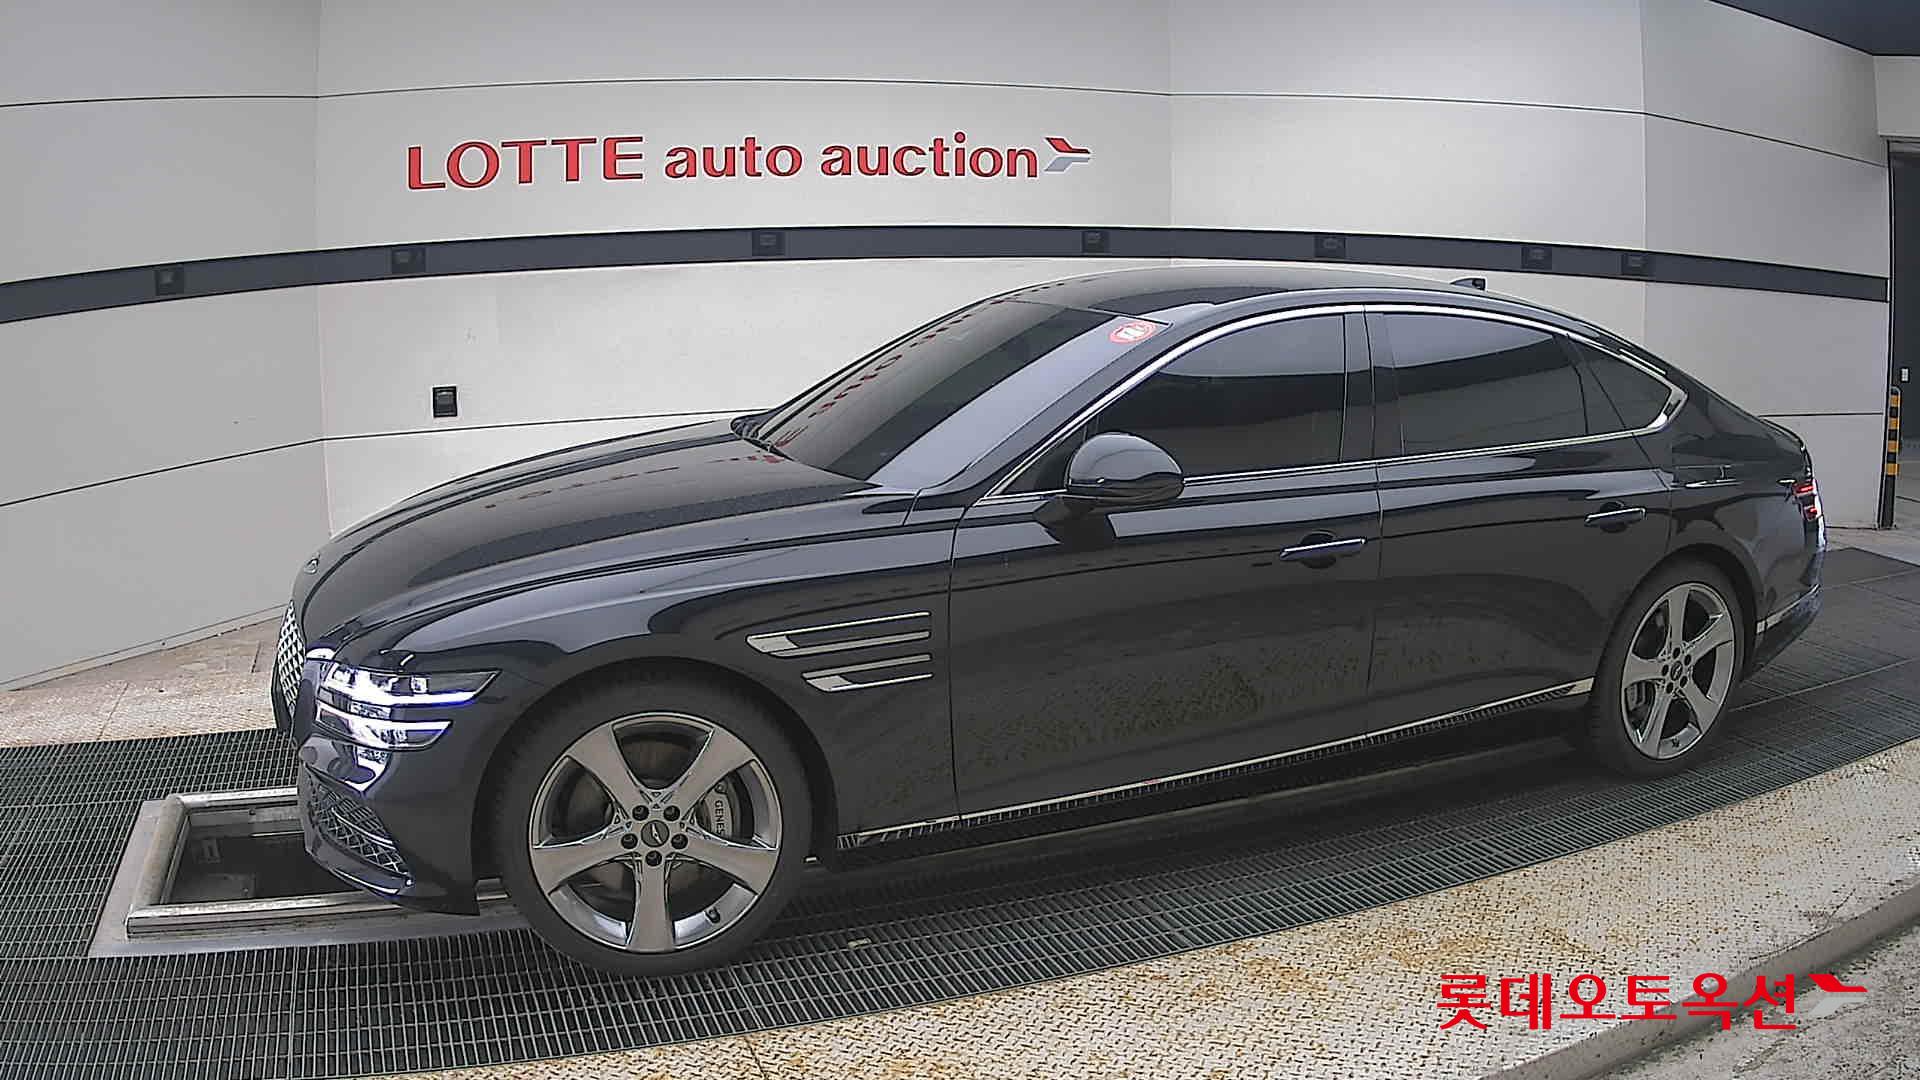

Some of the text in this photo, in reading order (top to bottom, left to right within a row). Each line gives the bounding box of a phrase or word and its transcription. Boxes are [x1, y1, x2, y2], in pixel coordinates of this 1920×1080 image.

[407, 131, 1039, 190] LOTTE auto auction
